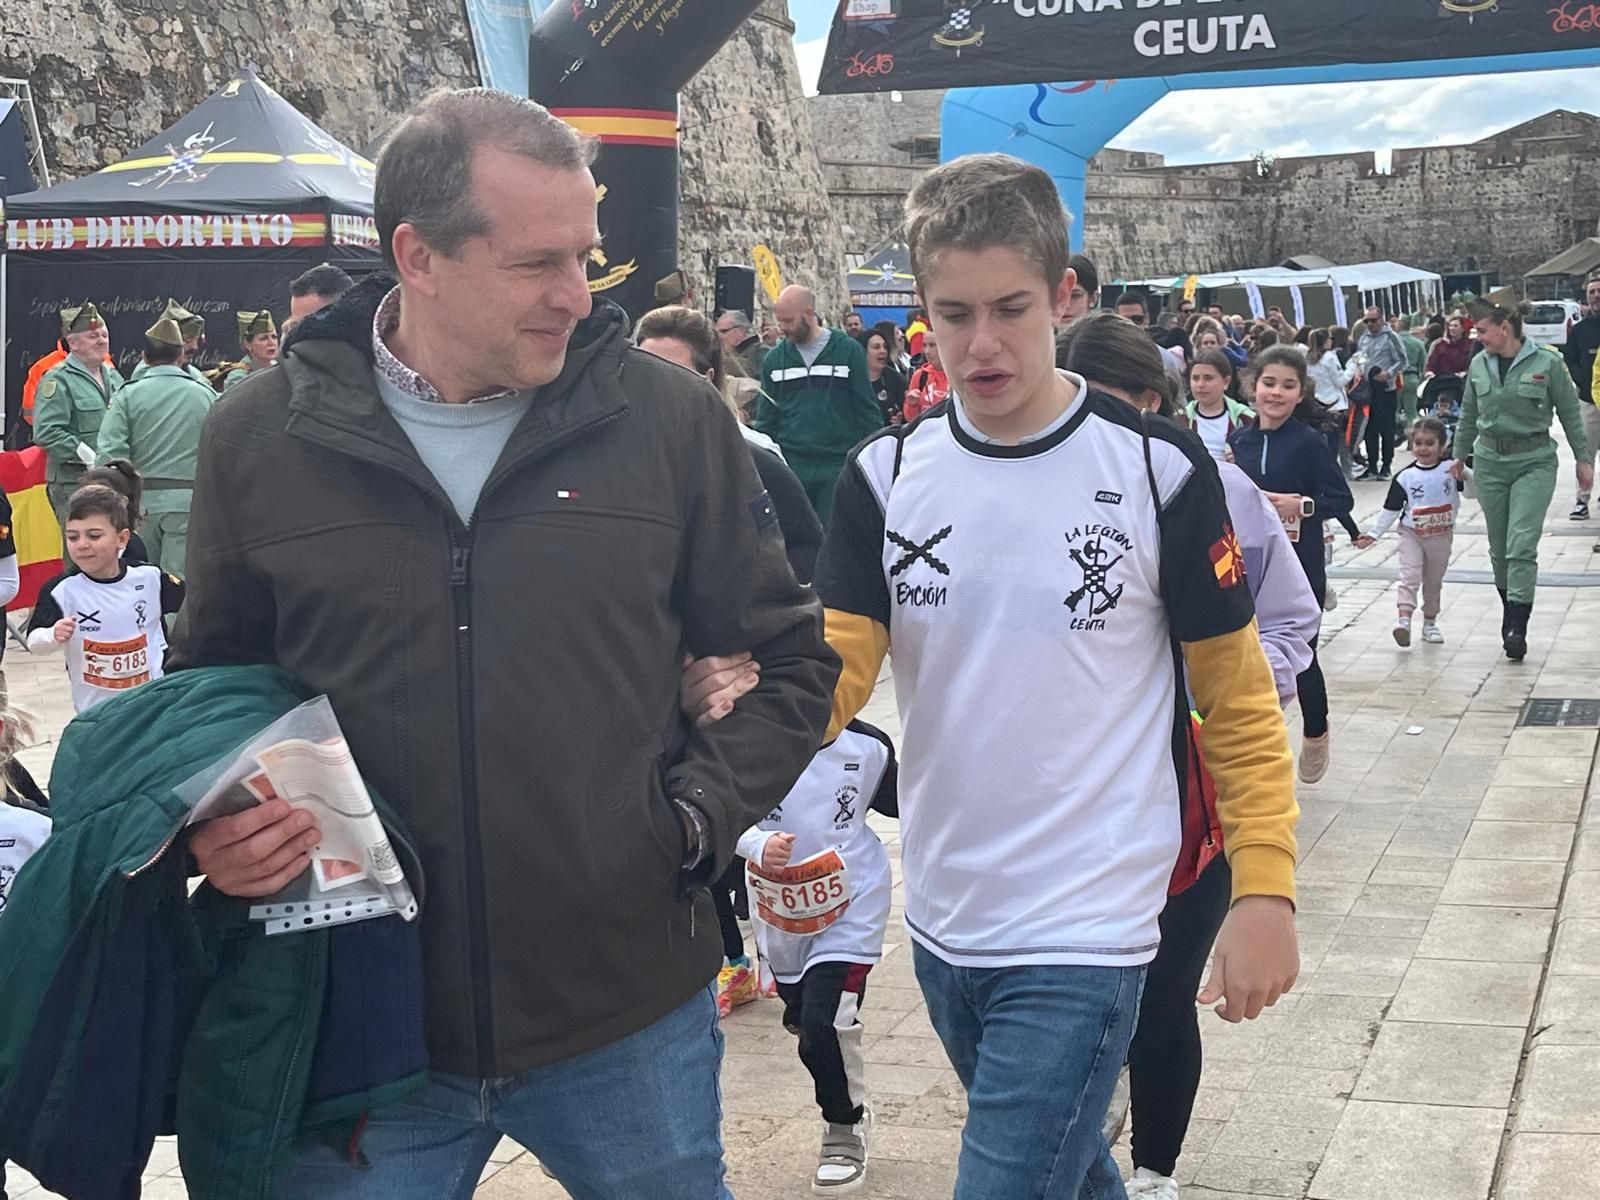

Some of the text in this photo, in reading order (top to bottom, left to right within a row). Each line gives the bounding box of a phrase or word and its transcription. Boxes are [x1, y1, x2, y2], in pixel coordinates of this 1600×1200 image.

[1133, 14, 1277, 57] CEUTA
[6, 213, 294, 250] LUB DEPORTIVO
[1065, 524, 1133, 551] LA LEGIÓN
[1070, 618, 1106, 631] CEUTA
[112, 650, 147, 672] 6183
[781, 876, 843, 910] 6185
